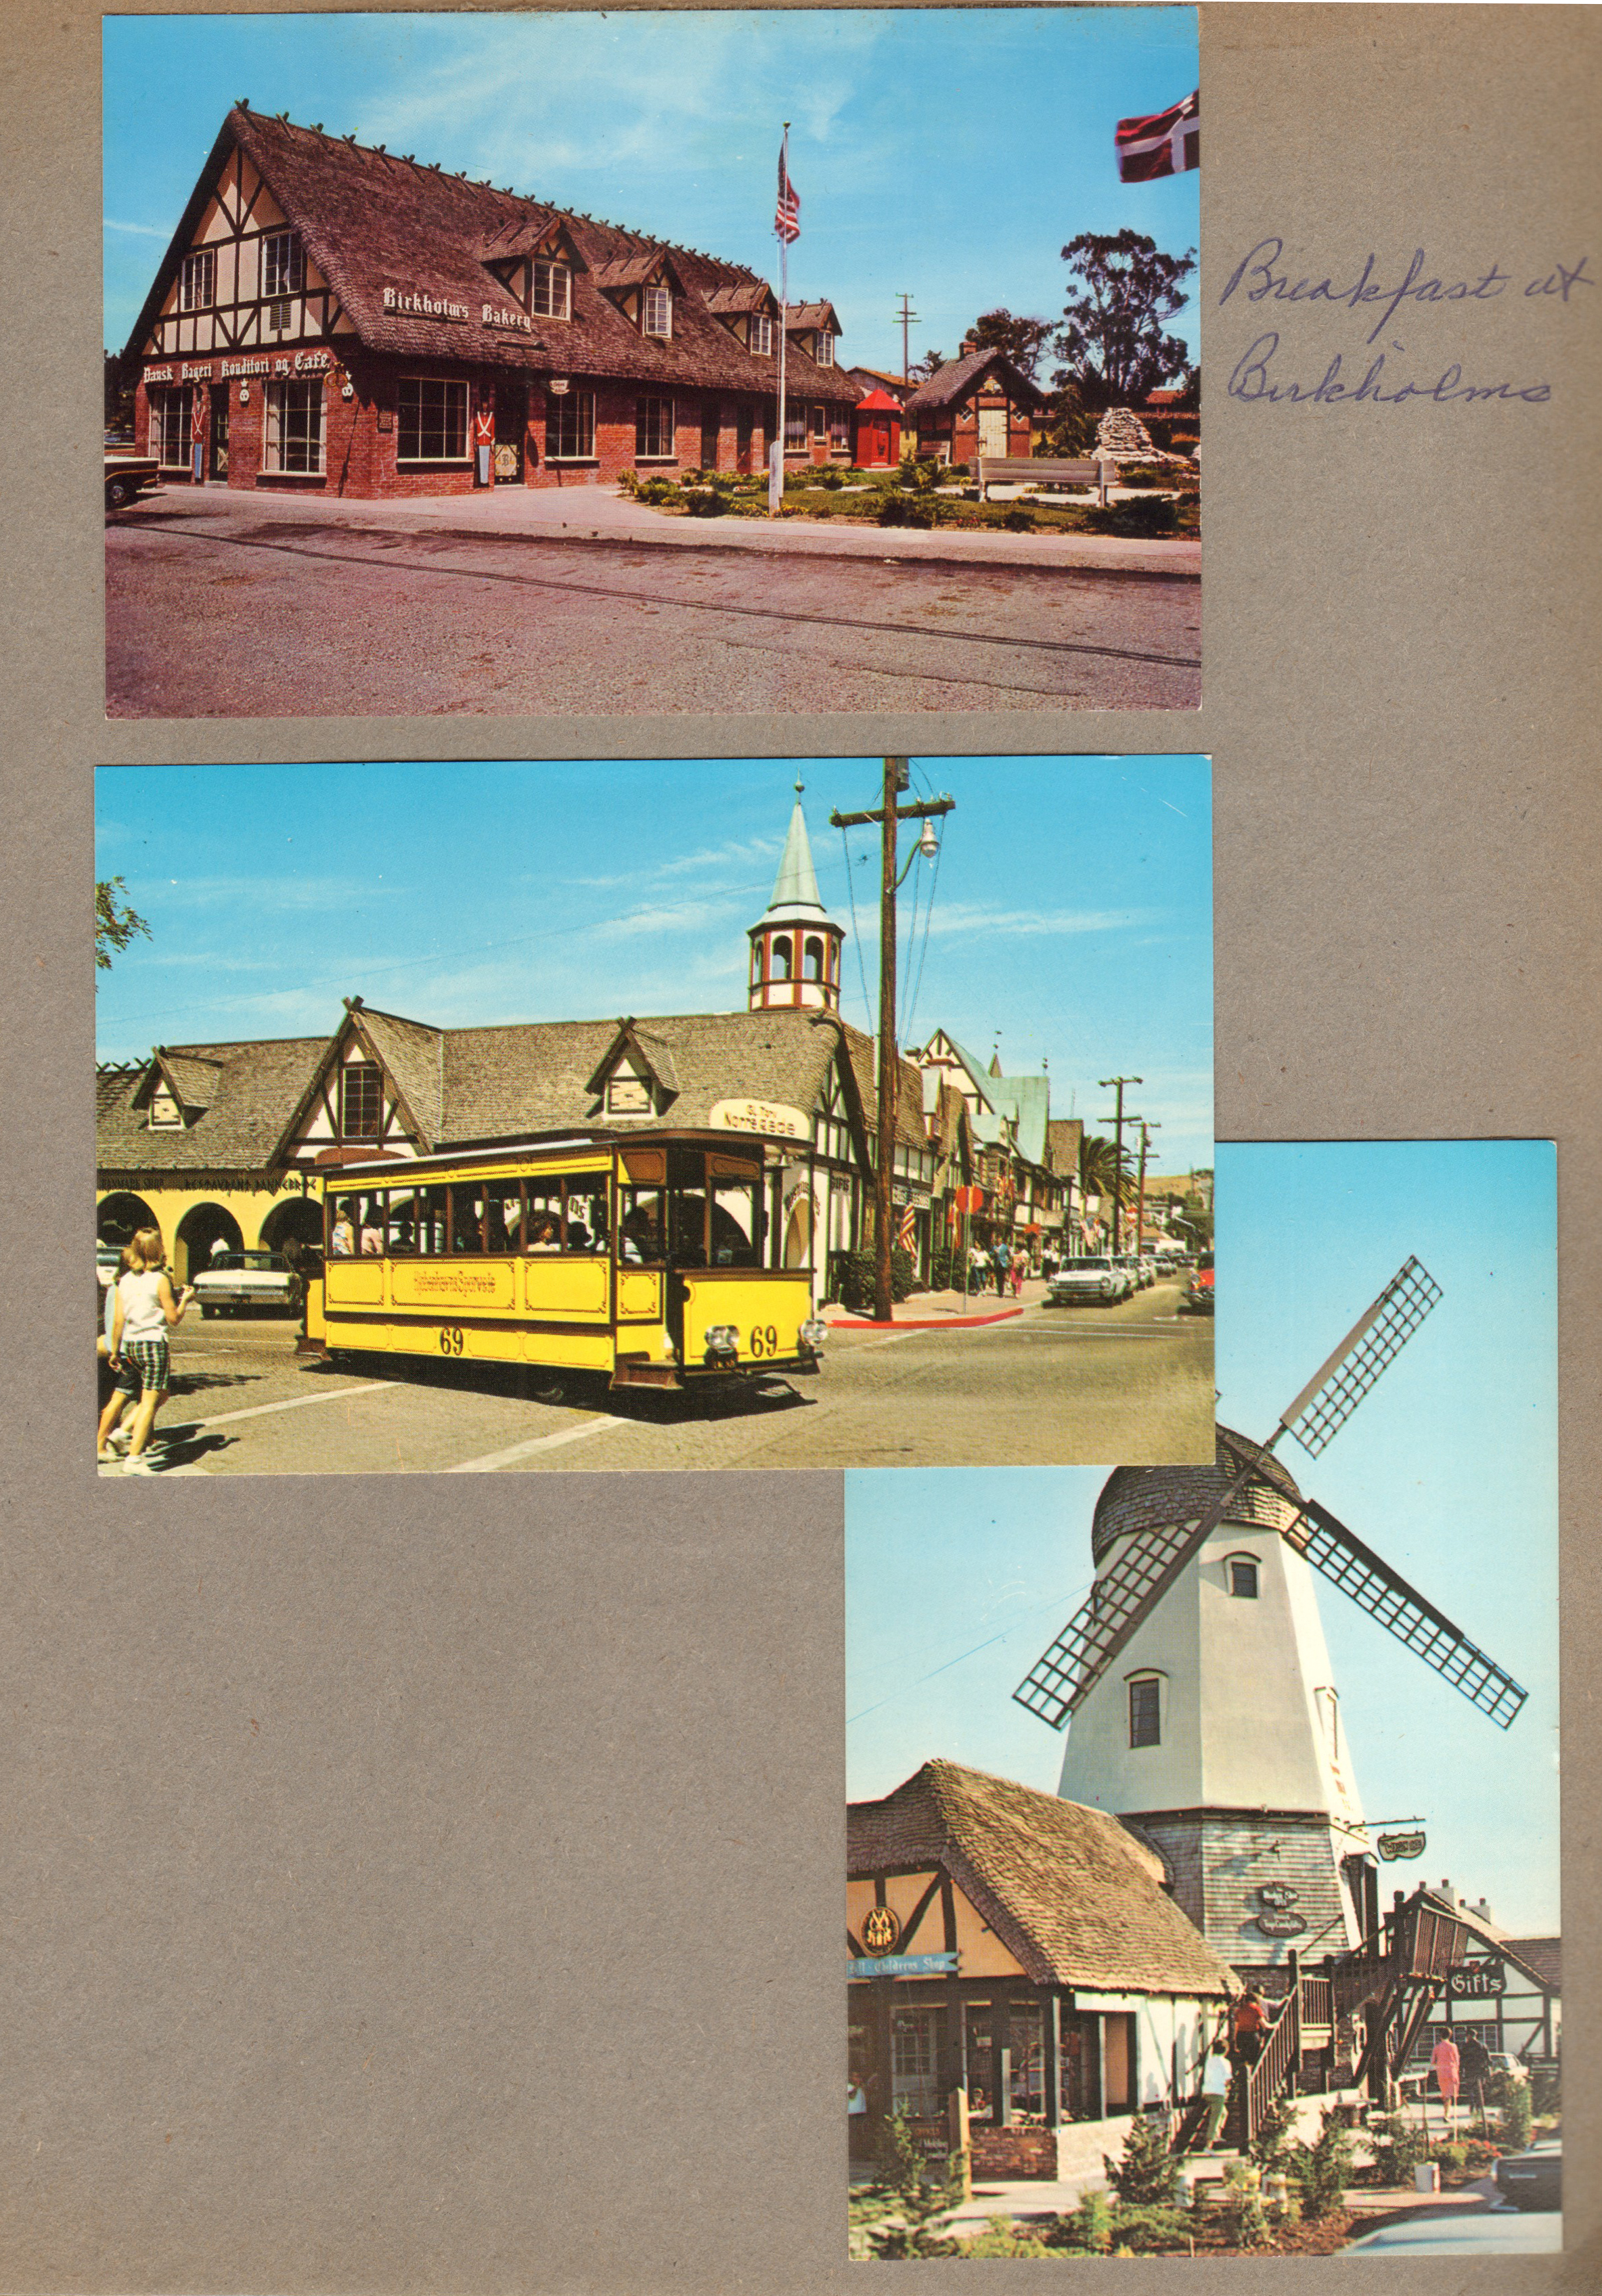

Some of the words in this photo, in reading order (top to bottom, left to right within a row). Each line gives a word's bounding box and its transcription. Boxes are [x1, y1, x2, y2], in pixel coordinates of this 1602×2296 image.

[1219, 236, 1512, 344] Breakfast
[1525, 256, 1595, 302] at
[482, 303, 531, 333] Bakery
[143, 365, 173, 383] Dansk
[181, 362, 212, 382] Bageri
[221, 357, 269, 378] Konditori
[275, 357, 290, 376] og
[439, 1327, 464, 1355] 69
[750, 1325, 778, 1357] 69
[1451, 1973, 1502, 1994] Gifts
